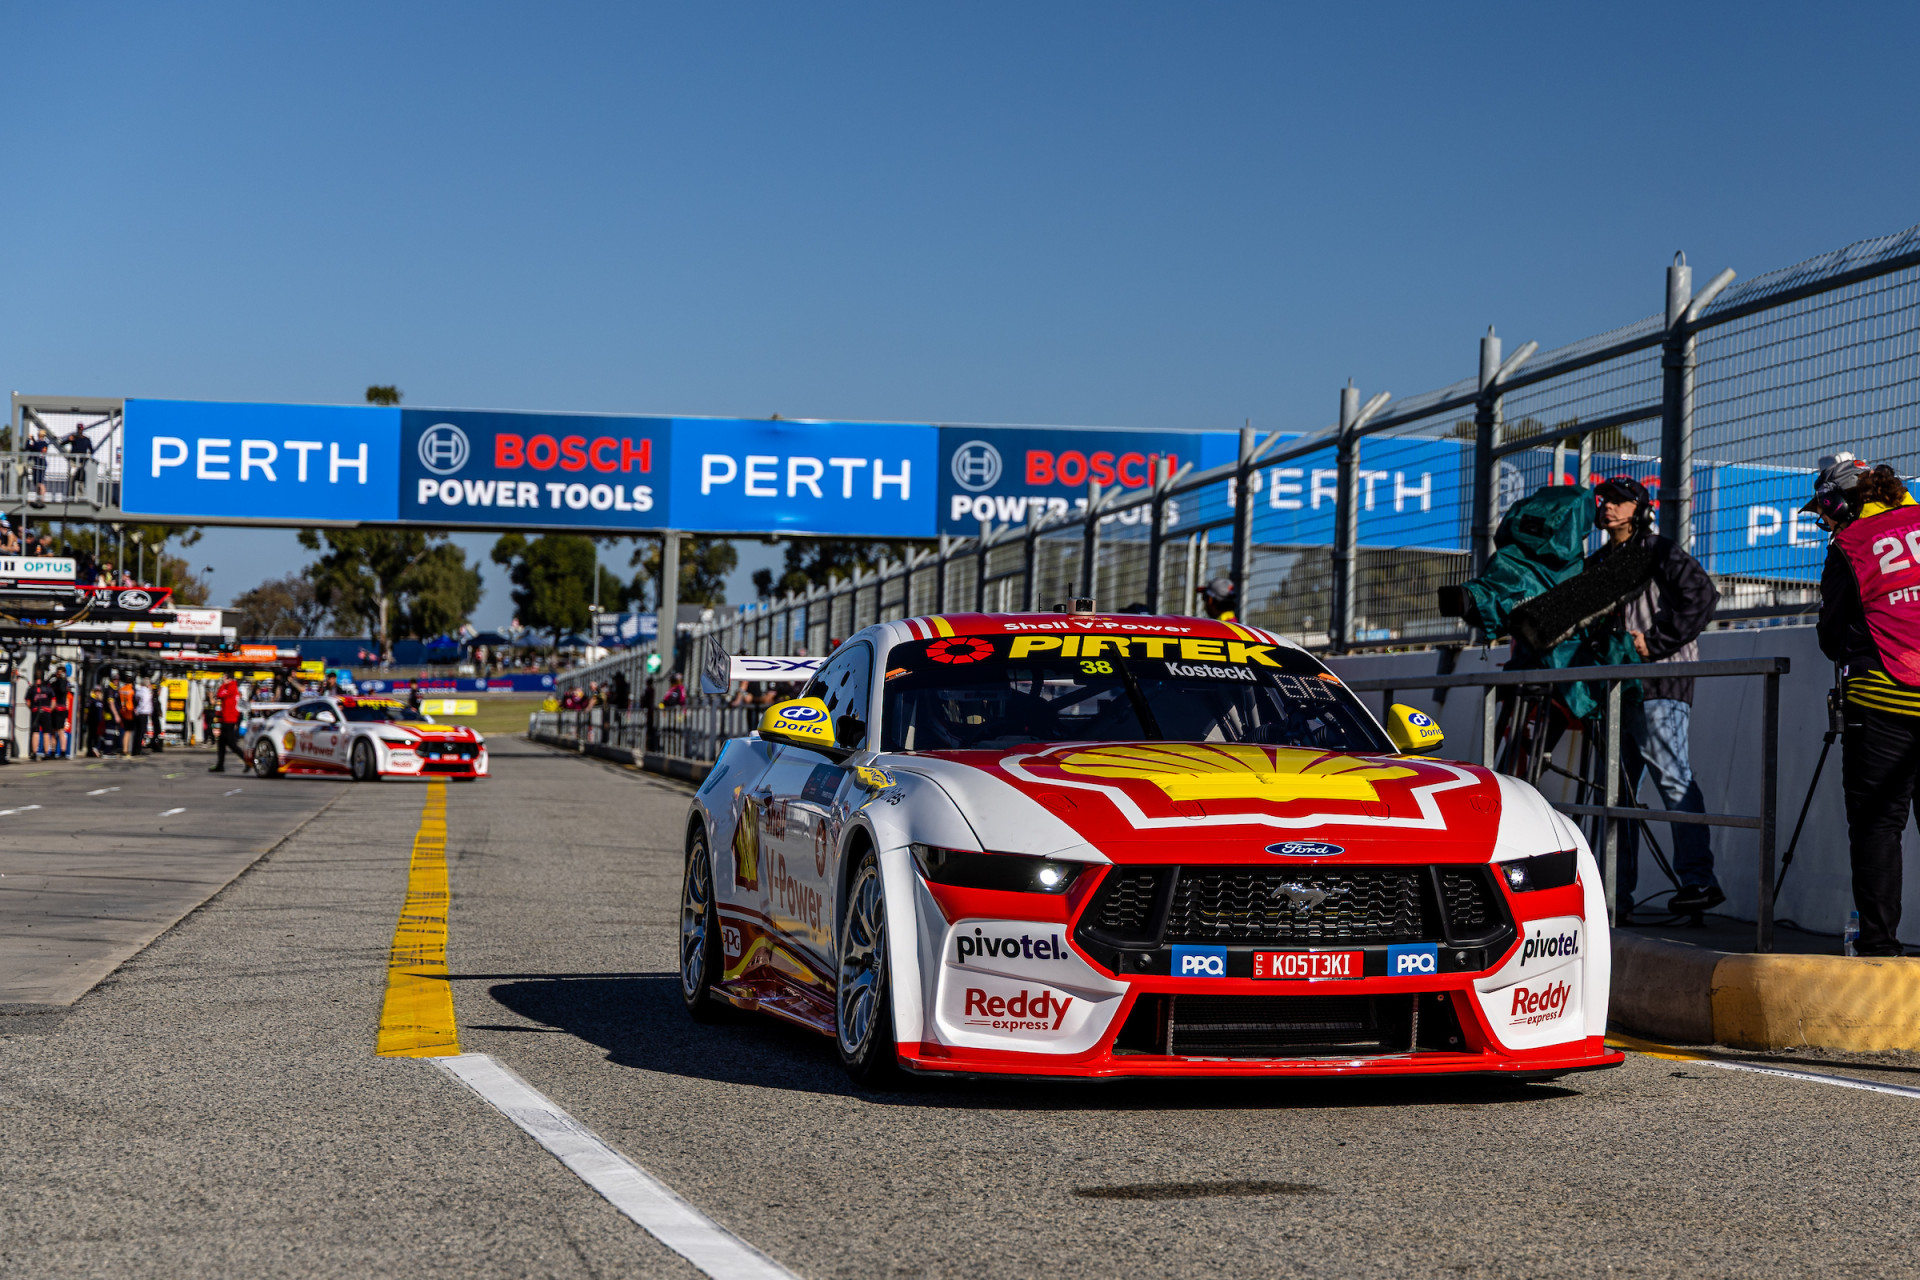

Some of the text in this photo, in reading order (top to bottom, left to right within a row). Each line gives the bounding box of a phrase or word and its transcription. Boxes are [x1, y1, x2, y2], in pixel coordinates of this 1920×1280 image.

[151, 436, 368, 484] PERTH
[494, 433, 652, 473] BOSCH
[701, 454, 911, 501] PERTH
[417, 478, 653, 512] POWER TOOLS
[24, 561, 72, 573] OPTUS
[1004, 621, 1191, 633] Shell V-Power
[1008, 635, 1283, 668] PIRTEK
[1079, 660, 1113, 674] 38
[1164, 661, 1258, 682] Kostecki
[773, 719, 824, 735] Doric
[764, 799, 788, 842] Shell
[1281, 842, 1329, 855] Ford
[764, 845, 823, 932] V-Power
[1182, 955, 1224, 975] PPQ
[1397, 954, 1436, 973] PPQ
[964, 987, 1074, 1030] Reddy
[1511, 980, 1571, 1018] Reddy
[992, 1017, 1048, 1032] express
[1526, 1010, 1558, 1026] express
